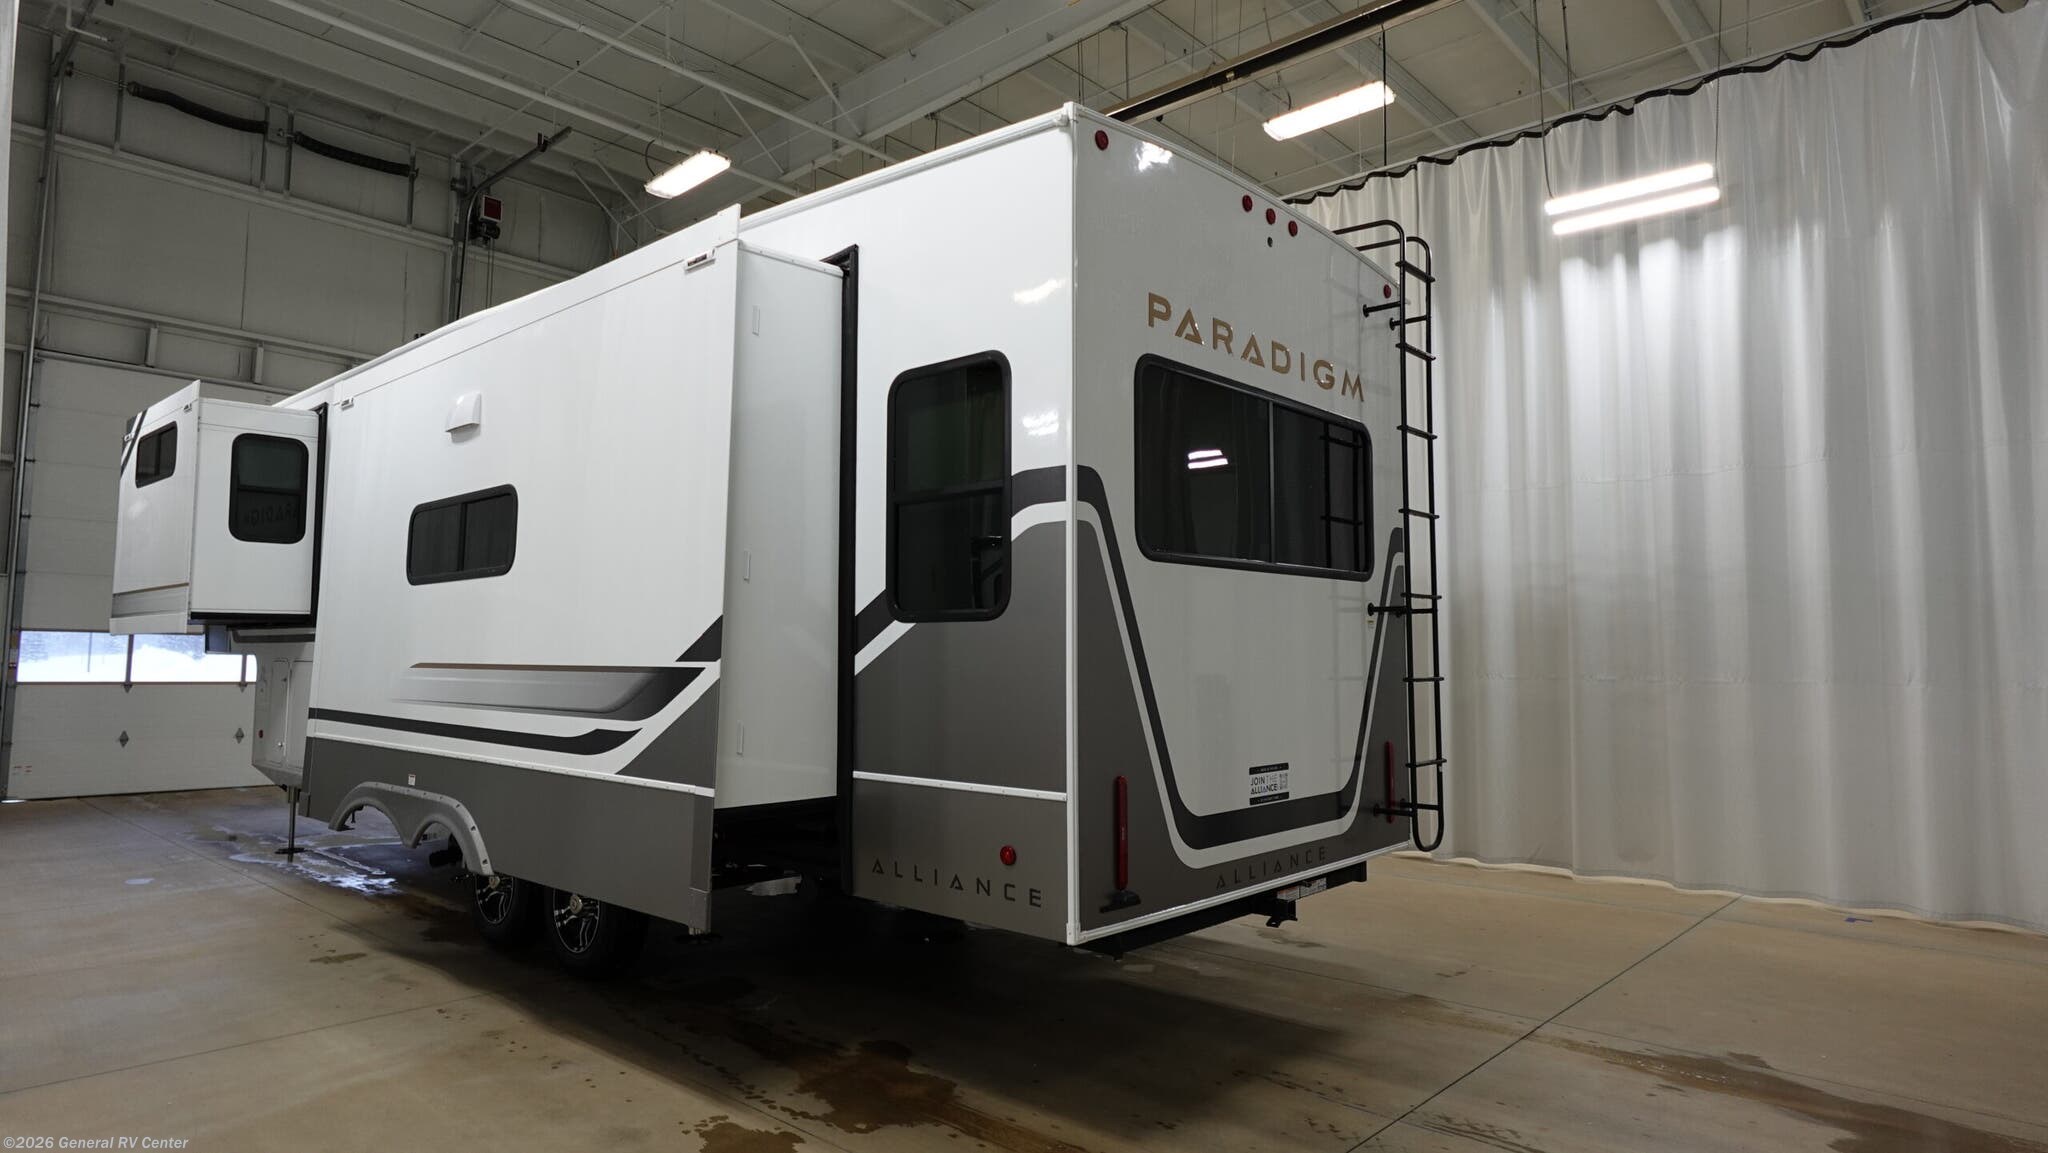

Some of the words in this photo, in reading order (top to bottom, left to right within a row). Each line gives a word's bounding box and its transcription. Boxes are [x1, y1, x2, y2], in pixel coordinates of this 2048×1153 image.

[1148, 292, 1364, 402] PARADIGM
[1250, 776, 1266, 786] JOIN
[1266, 773, 1278, 784] THE
[1250, 783, 1278, 795] ALLIANCE
[872, 858, 1042, 908] ALLIANCE
[1216, 846, 1328, 889] ALLIANCE
